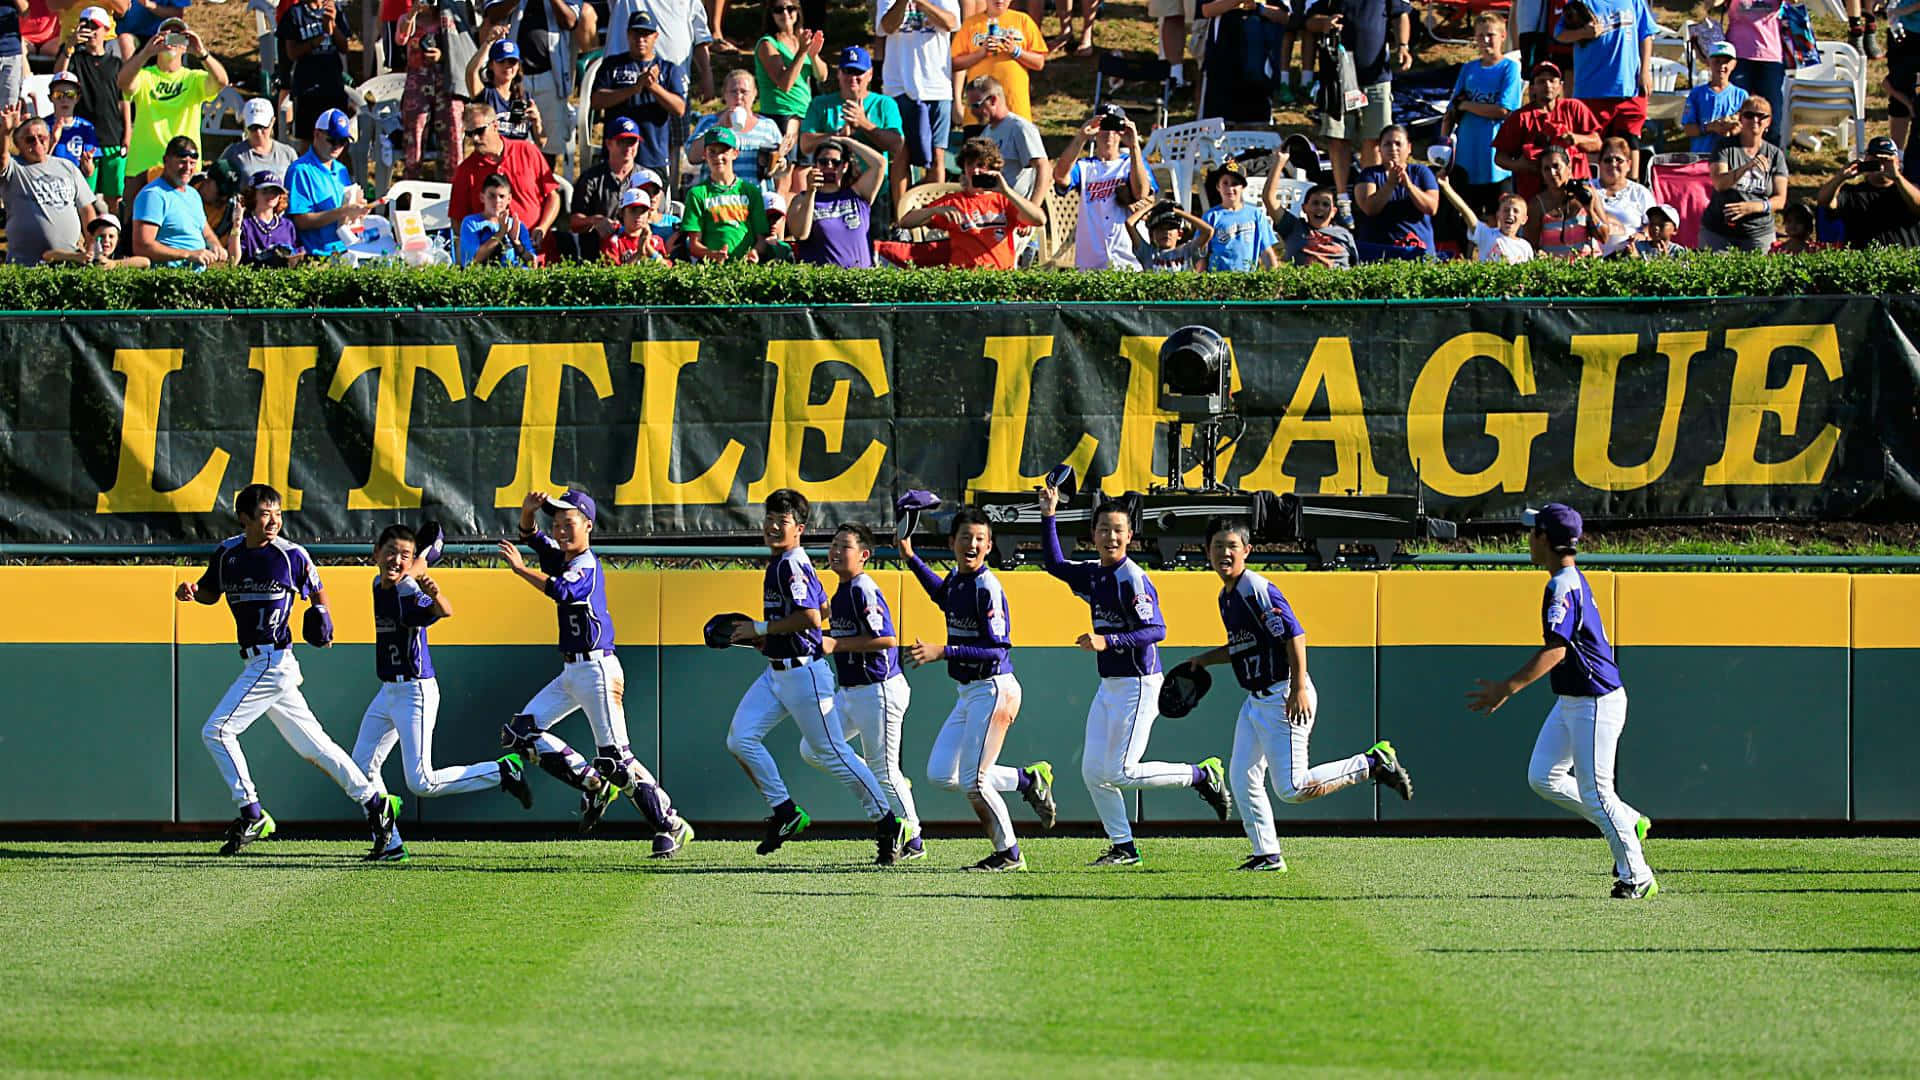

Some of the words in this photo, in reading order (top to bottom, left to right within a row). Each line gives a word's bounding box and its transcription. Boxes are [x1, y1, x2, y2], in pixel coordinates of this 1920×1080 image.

[96, 338, 890, 514] LITTLE
[966, 323, 1844, 501] LEAGUE
[256, 607, 280, 631] 14
[568, 613, 581, 637] 5
[388, 643, 402, 665] 2
[1244, 655, 1262, 680] 17
